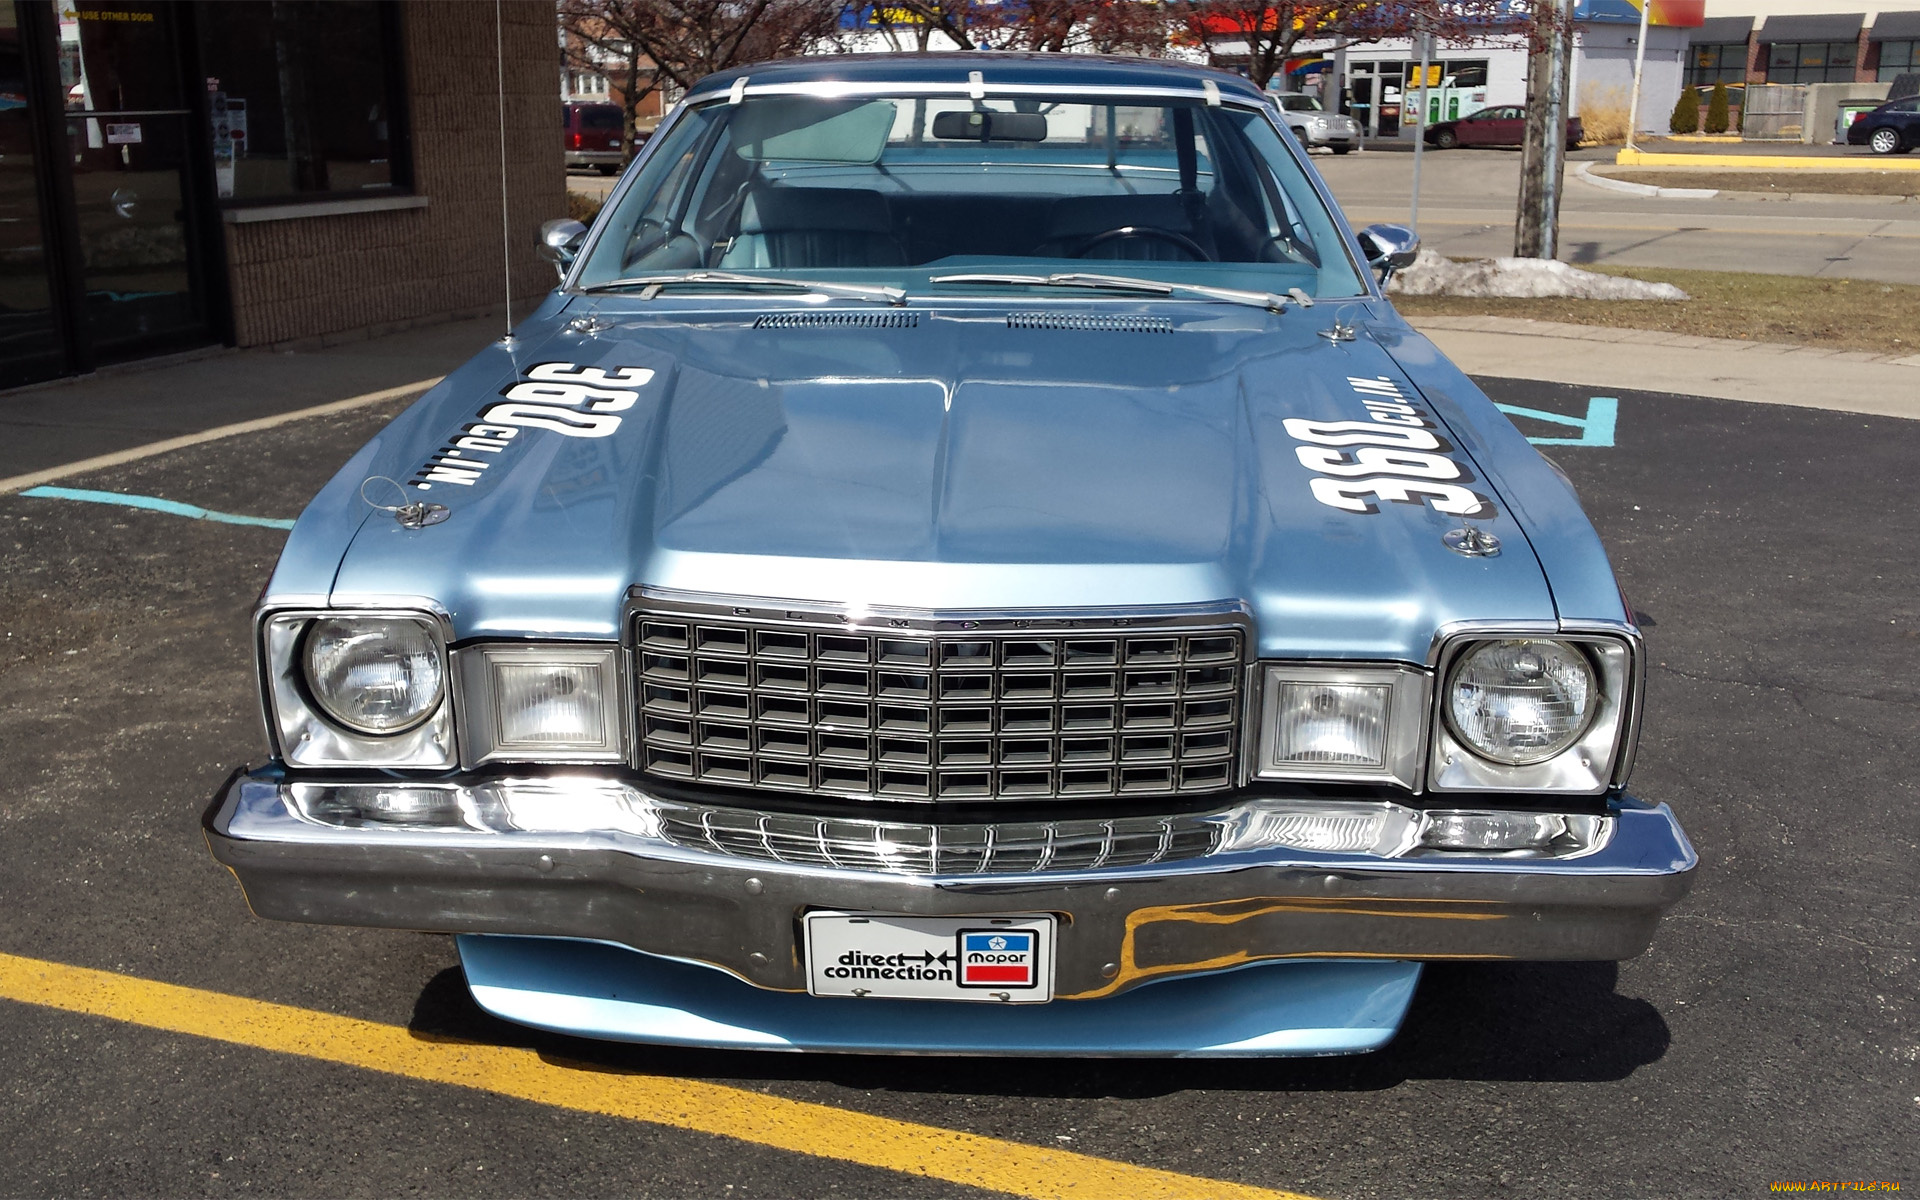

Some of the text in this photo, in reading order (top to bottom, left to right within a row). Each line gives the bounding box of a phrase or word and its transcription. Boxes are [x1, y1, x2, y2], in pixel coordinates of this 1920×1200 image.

[82, 11, 154, 22] USE OTHER DOOR
[475, 361, 655, 438] 360
[1282, 418, 1494, 517] 360
[838, 950, 905, 968] direct
[824, 964, 953, 981] connection
